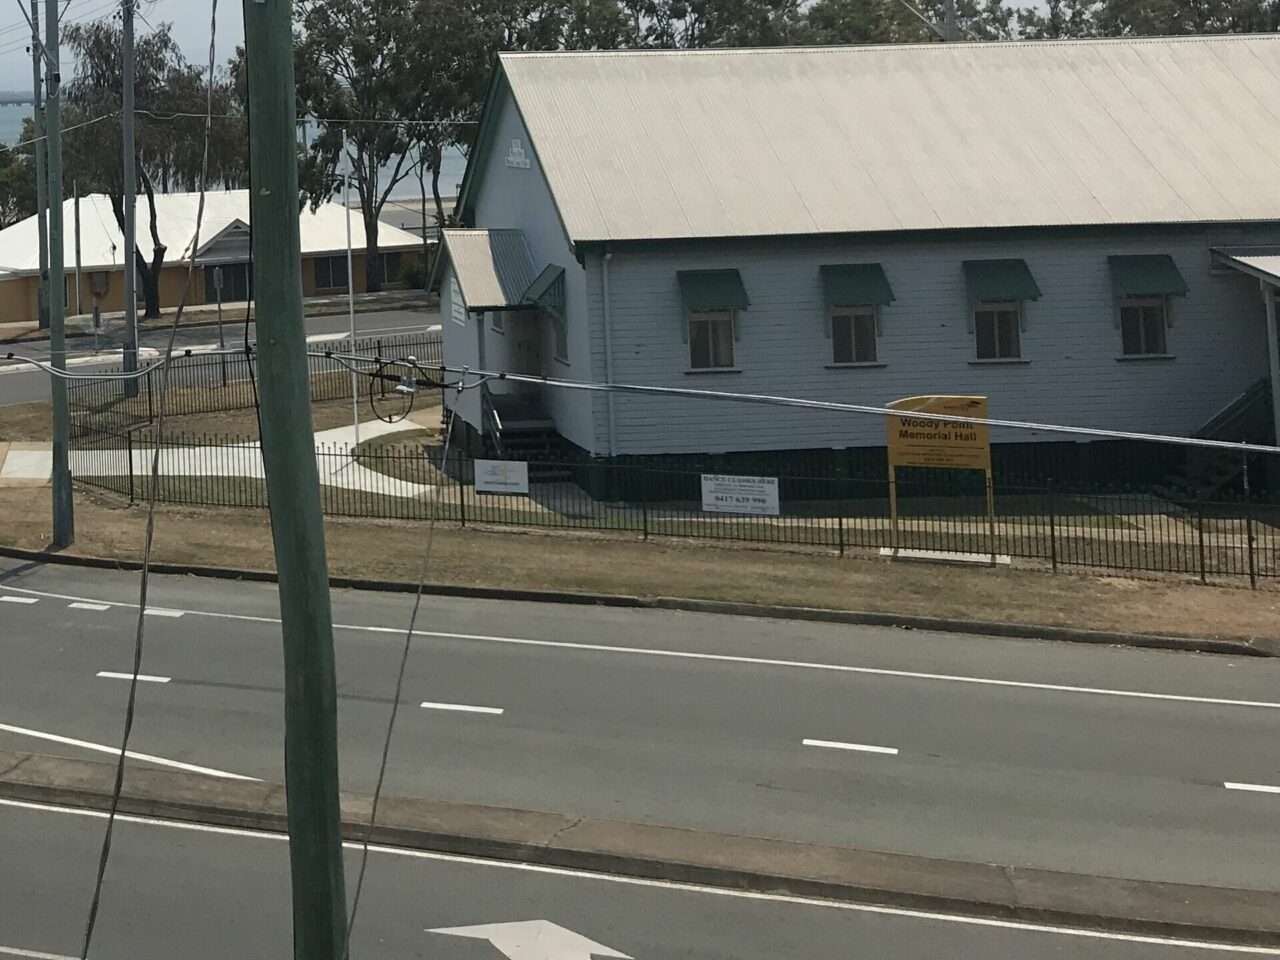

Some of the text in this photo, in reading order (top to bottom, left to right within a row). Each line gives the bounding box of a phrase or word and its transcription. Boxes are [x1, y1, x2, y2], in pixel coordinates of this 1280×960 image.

[900, 418, 975, 430] Woody Point
[898, 429, 977, 441] Memorial Hall
